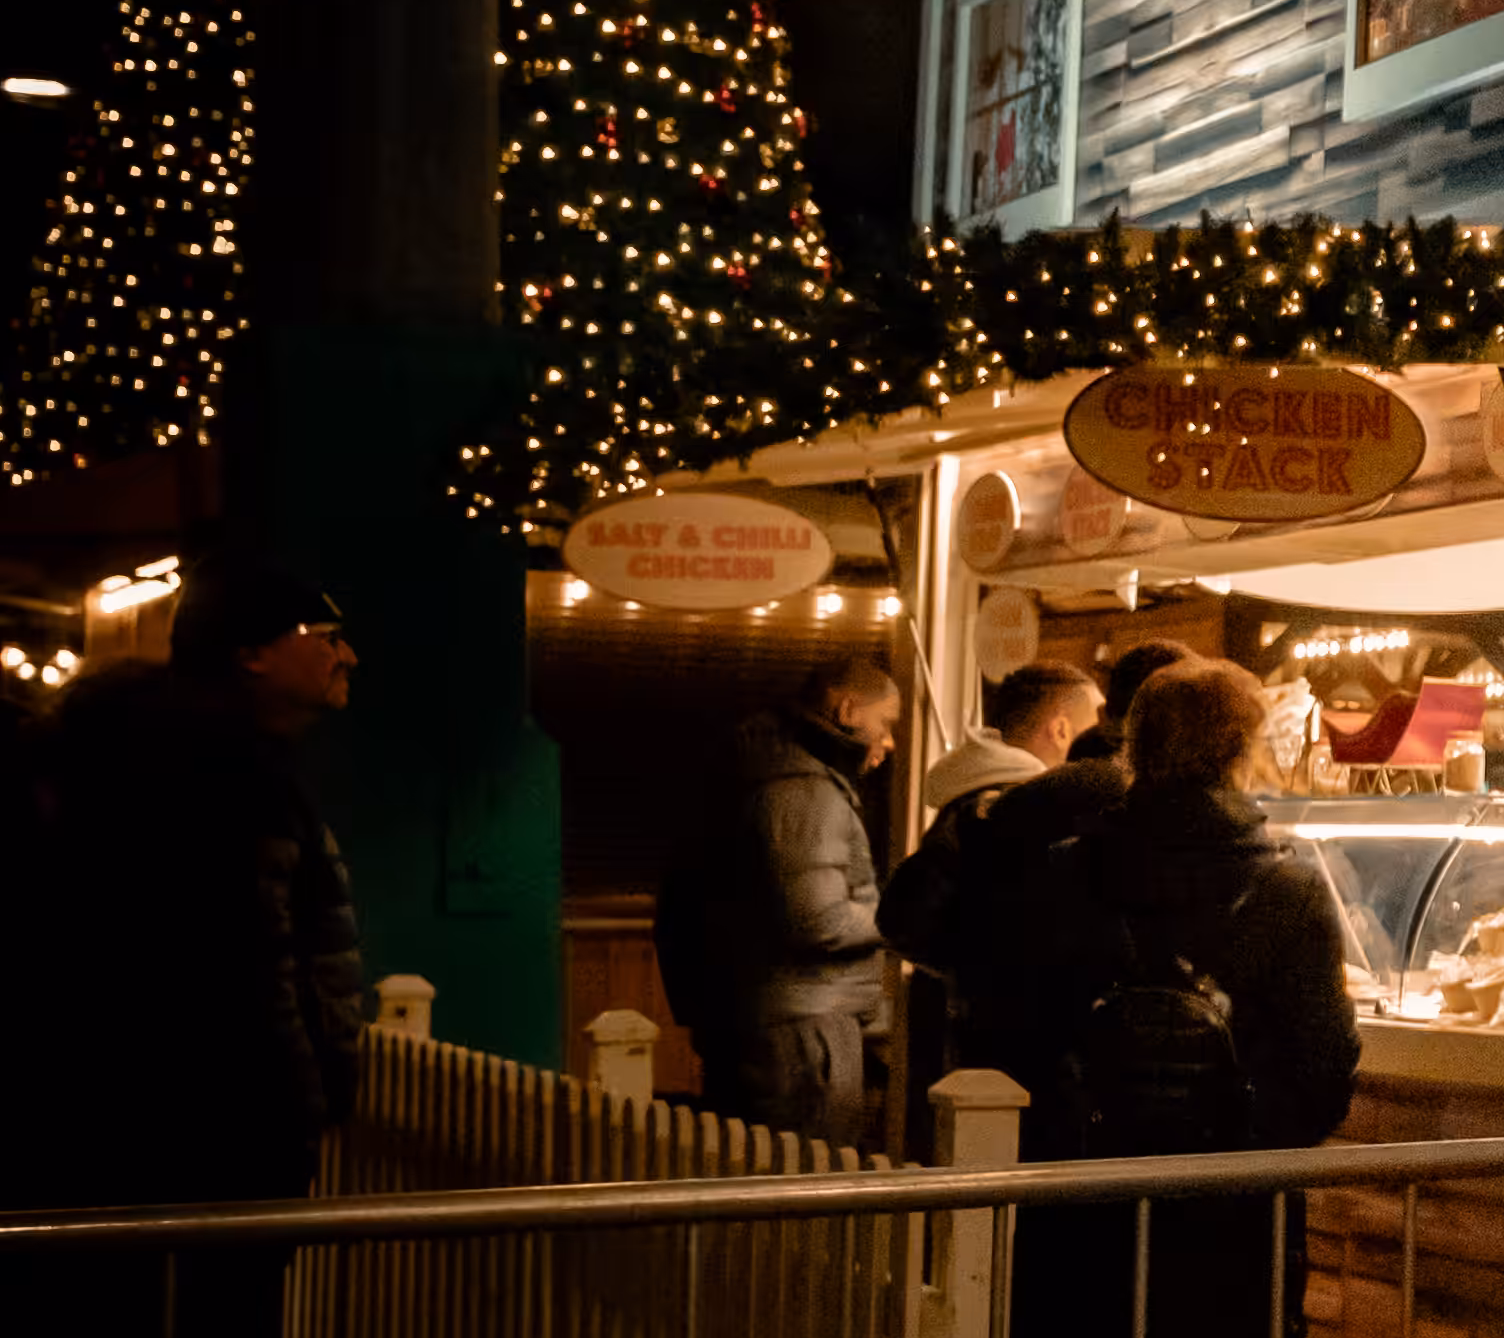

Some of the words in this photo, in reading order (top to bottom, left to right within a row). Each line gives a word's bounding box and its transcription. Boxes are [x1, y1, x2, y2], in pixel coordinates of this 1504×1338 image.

[1104, 380, 1392, 442] CHICKEN
[1147, 443, 1354, 496] STACK
[587, 521, 669, 548] SALT
[677, 524, 700, 548] &
[712, 525, 811, 550] CHILLI
[626, 553, 775, 580] CHICKEN
